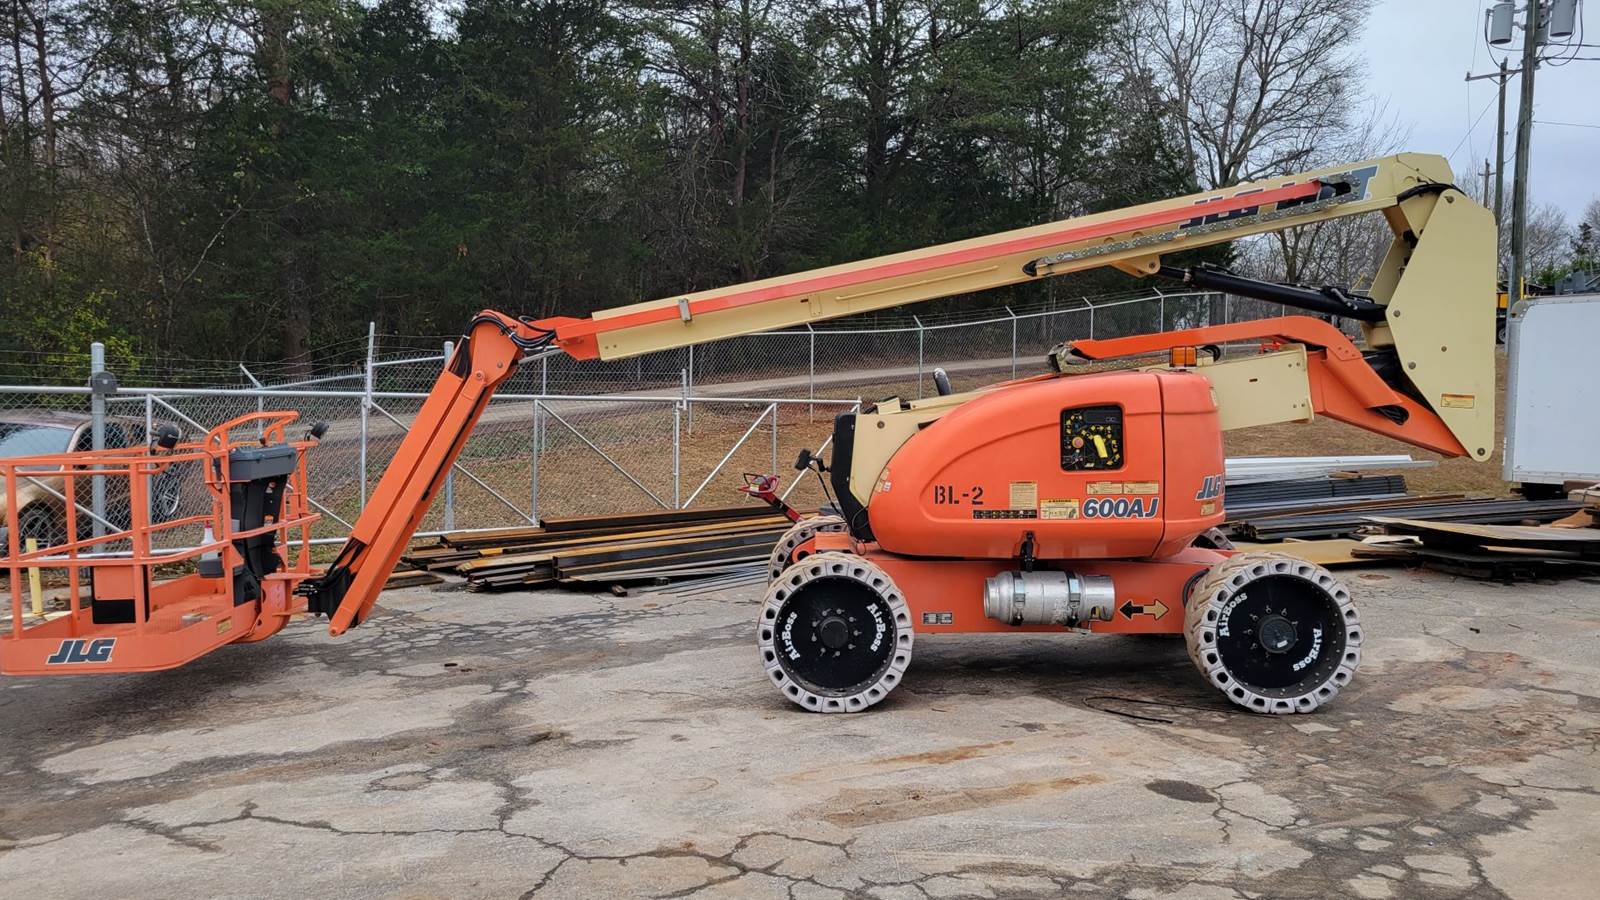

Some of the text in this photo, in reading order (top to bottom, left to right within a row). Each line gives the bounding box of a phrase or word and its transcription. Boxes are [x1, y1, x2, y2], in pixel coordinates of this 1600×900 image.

[935, 485, 983, 505] BL-2
[1083, 497, 1159, 519] 600AJ
[782, 611, 801, 661] AirBoss
[866, 603, 886, 652] AirBoss
[1218, 593, 1248, 637] AirBoss
[46, 637, 117, 665] JLG
[1292, 627, 1323, 671] AirBoss
